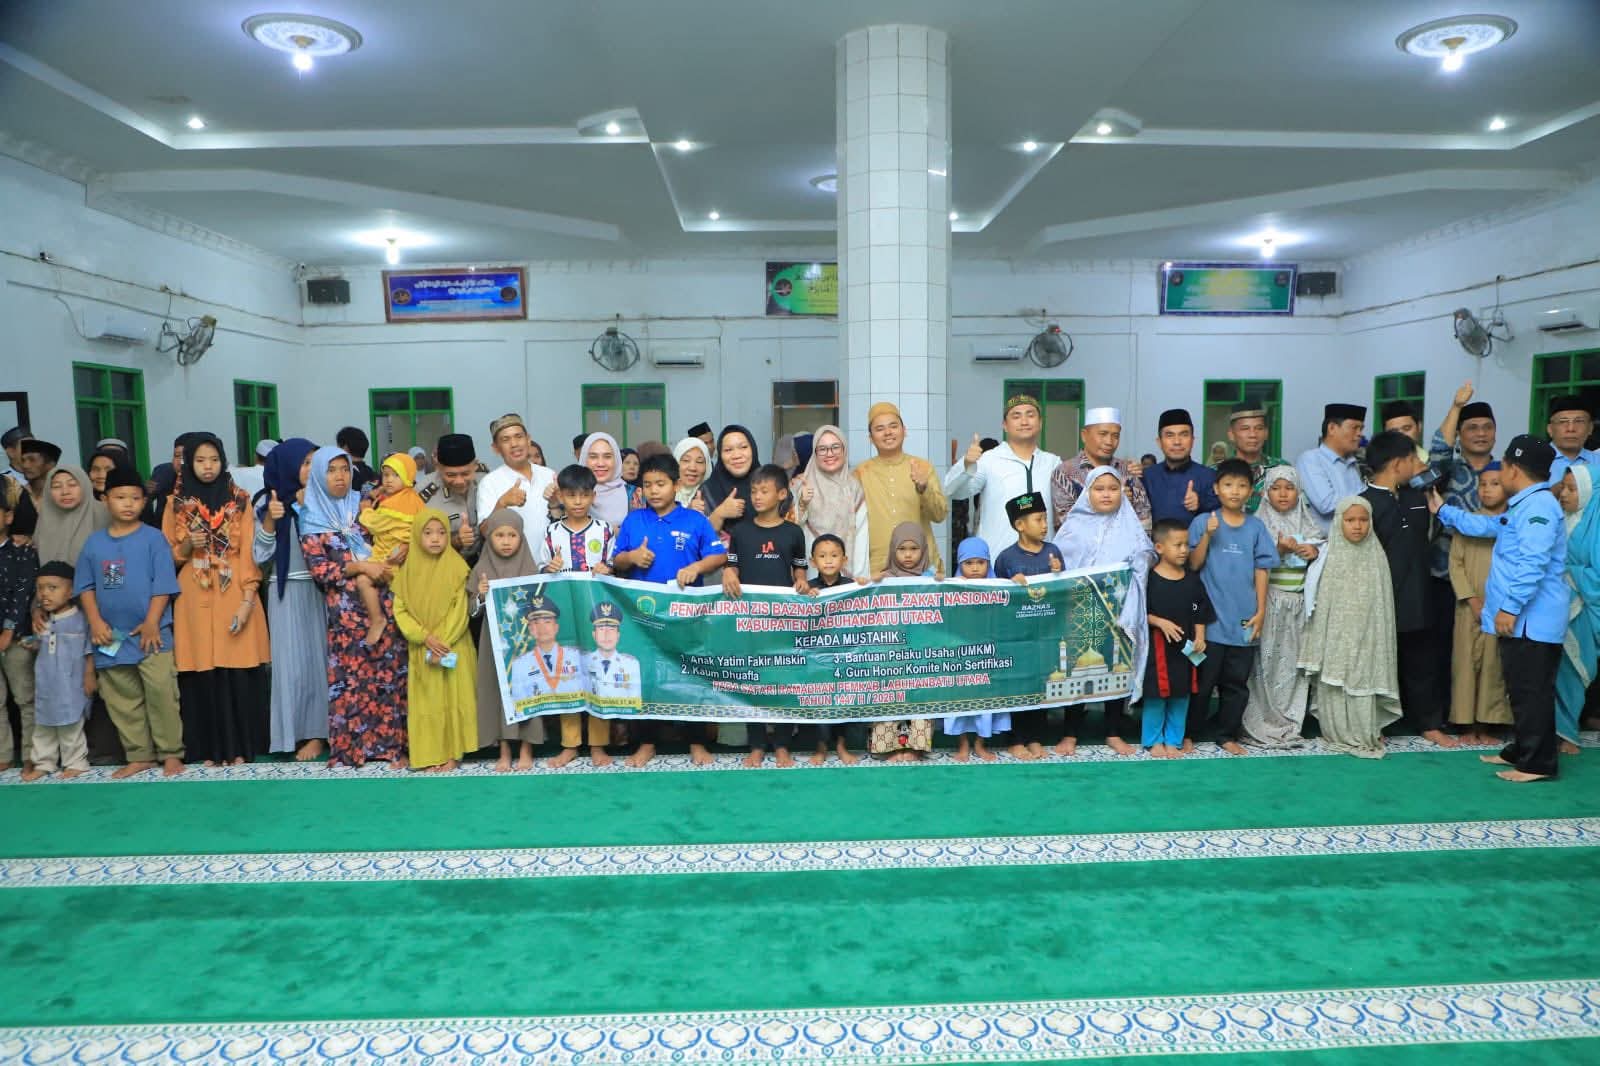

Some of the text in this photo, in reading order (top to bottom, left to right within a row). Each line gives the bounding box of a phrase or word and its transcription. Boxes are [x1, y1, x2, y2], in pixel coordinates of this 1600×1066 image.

[669, 590, 1010, 617] PENYALURAN ZIS BAZNAS (BADAN AMIL ZAKAT NASIONAL)
[736, 610, 943, 632] KABUPATEN LABUHANBATU UTARA
[795, 634, 840, 647] KEPADA
[843, 631, 899, 644] MUSTAHIK
[690, 655, 714, 666] Anak
[717, 655, 745, 667] Yatim
[747, 655, 770, 667] Fakir
[773, 654, 806, 666] Miskin
[834, 643, 995, 663] 3. Bantuan Pelaku Usaha (UMKM)
[681, 664, 690, 674] 2.
[692, 665, 720, 678] Kaum
[834, 657, 1013, 679] 4. Guru Honor Komite Non Sertifikasi
[712, 673, 990, 695] PADA SAFARI RAMADHAN PEMKAB LABUHANBATU UTARA
[799, 695, 832, 706] TAHUN
[833, 693, 857, 705] 1447
[857, 692, 865, 704] H
[872, 691, 895, 704] 2026
[896, 691, 905, 702] M
